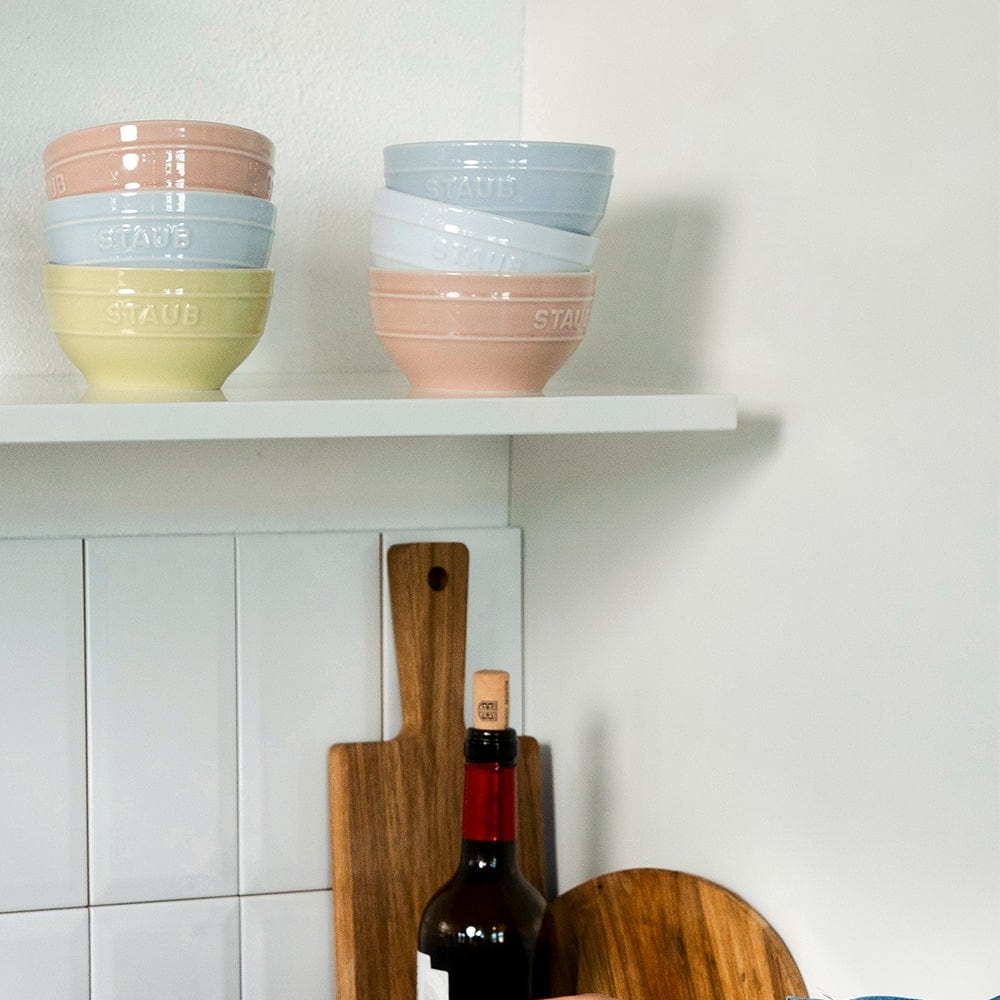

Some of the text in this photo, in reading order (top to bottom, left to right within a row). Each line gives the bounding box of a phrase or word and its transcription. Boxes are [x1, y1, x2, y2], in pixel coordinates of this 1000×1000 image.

[424, 174, 517, 200] STAUB
[101, 223, 191, 249] STAUB
[106, 302, 200, 326] STAUB
[533, 308, 590, 330] STAU
